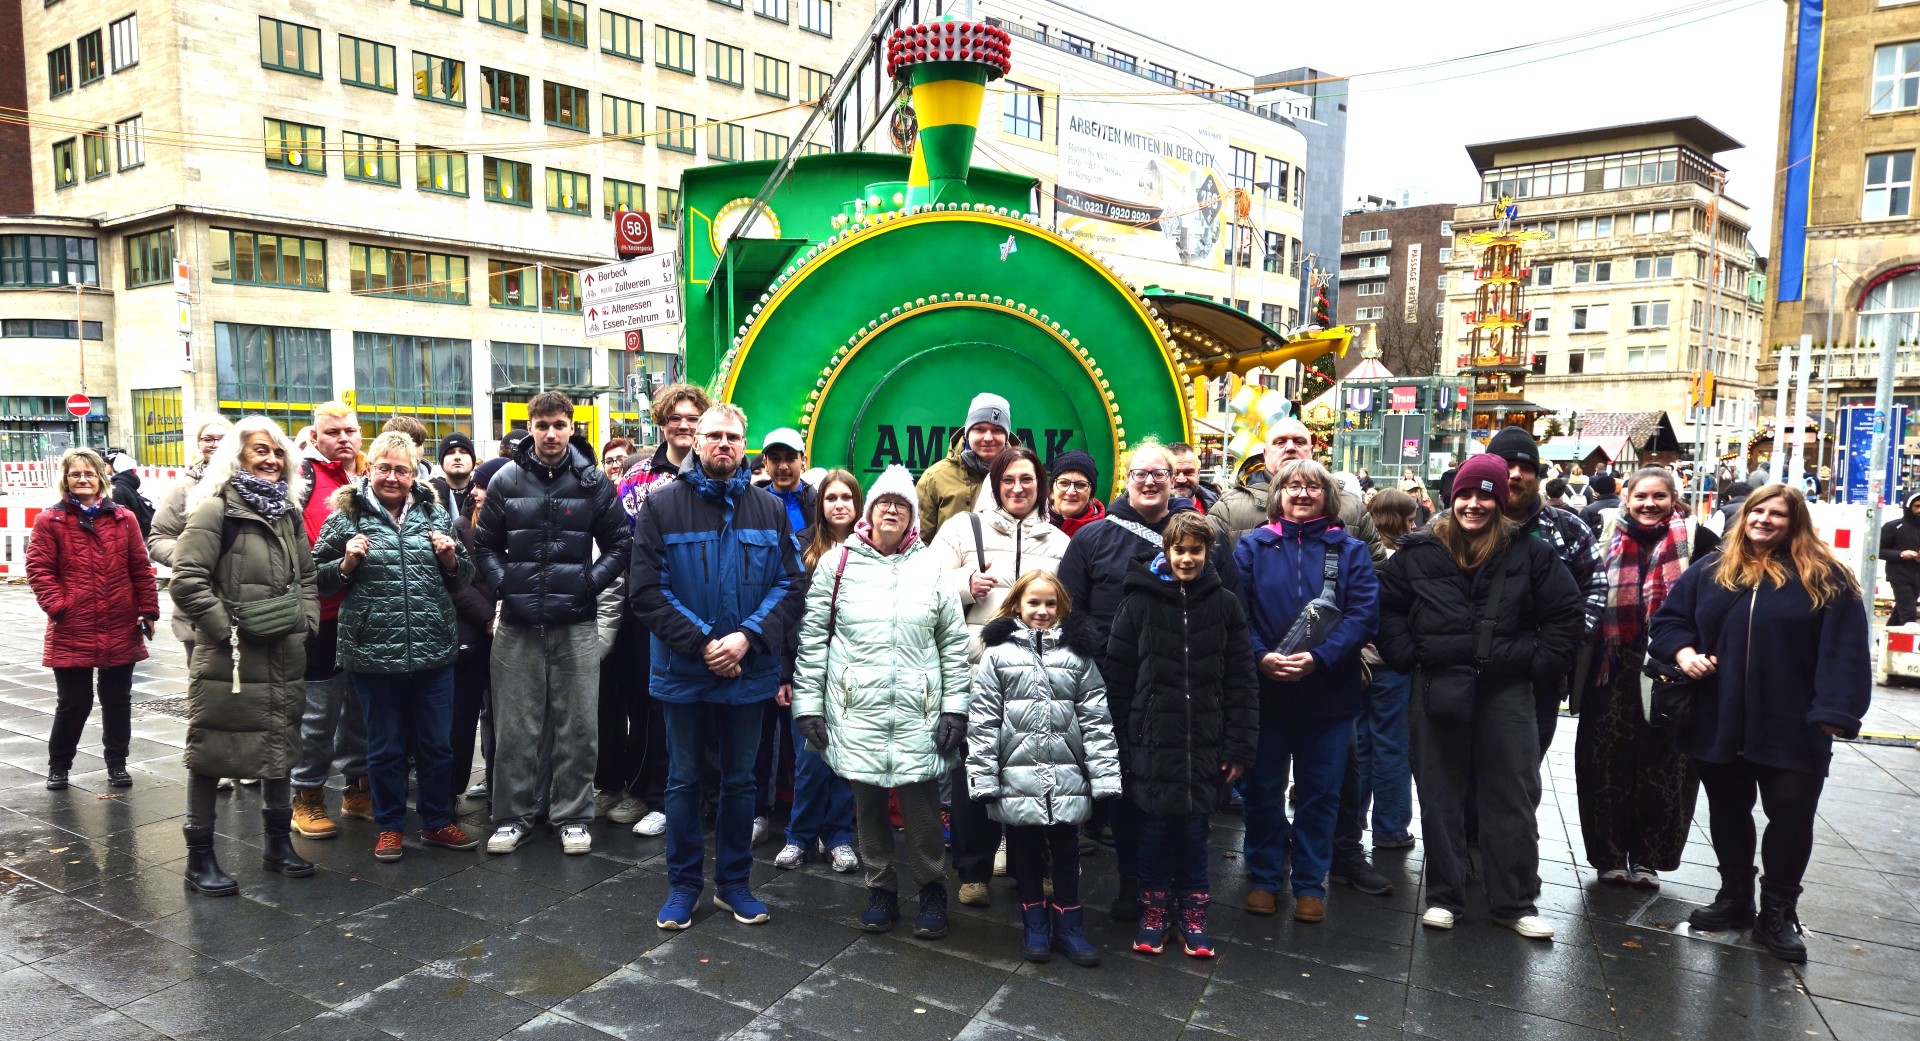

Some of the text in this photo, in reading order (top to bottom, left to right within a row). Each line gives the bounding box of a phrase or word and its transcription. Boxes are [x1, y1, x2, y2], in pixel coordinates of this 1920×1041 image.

[1069, 115, 1216, 169] ARBEITEN MITTEN IN DER CITY
[1067, 194, 1084, 210] Tel.:
[1084, 201, 1104, 214] 0221
[1110, 206, 1130, 219] 9920
[1131, 210, 1151, 223] 9920
[627, 221, 642, 236] 58
[1409, 249, 1418, 282] PASSAGE
[598, 267, 628, 282] Borbeck
[615, 277, 651, 293] Zollverein
[612, 300, 652, 314] Altenessen
[1407, 285, 1417, 321] THEATER
[603, 313, 659, 330] Essen-Zentrum
[629, 336, 637, 346] 57
[1353, 388, 1370, 410] U
[1393, 394, 1416, 404] Tram
[1441, 387, 1449, 409] U
